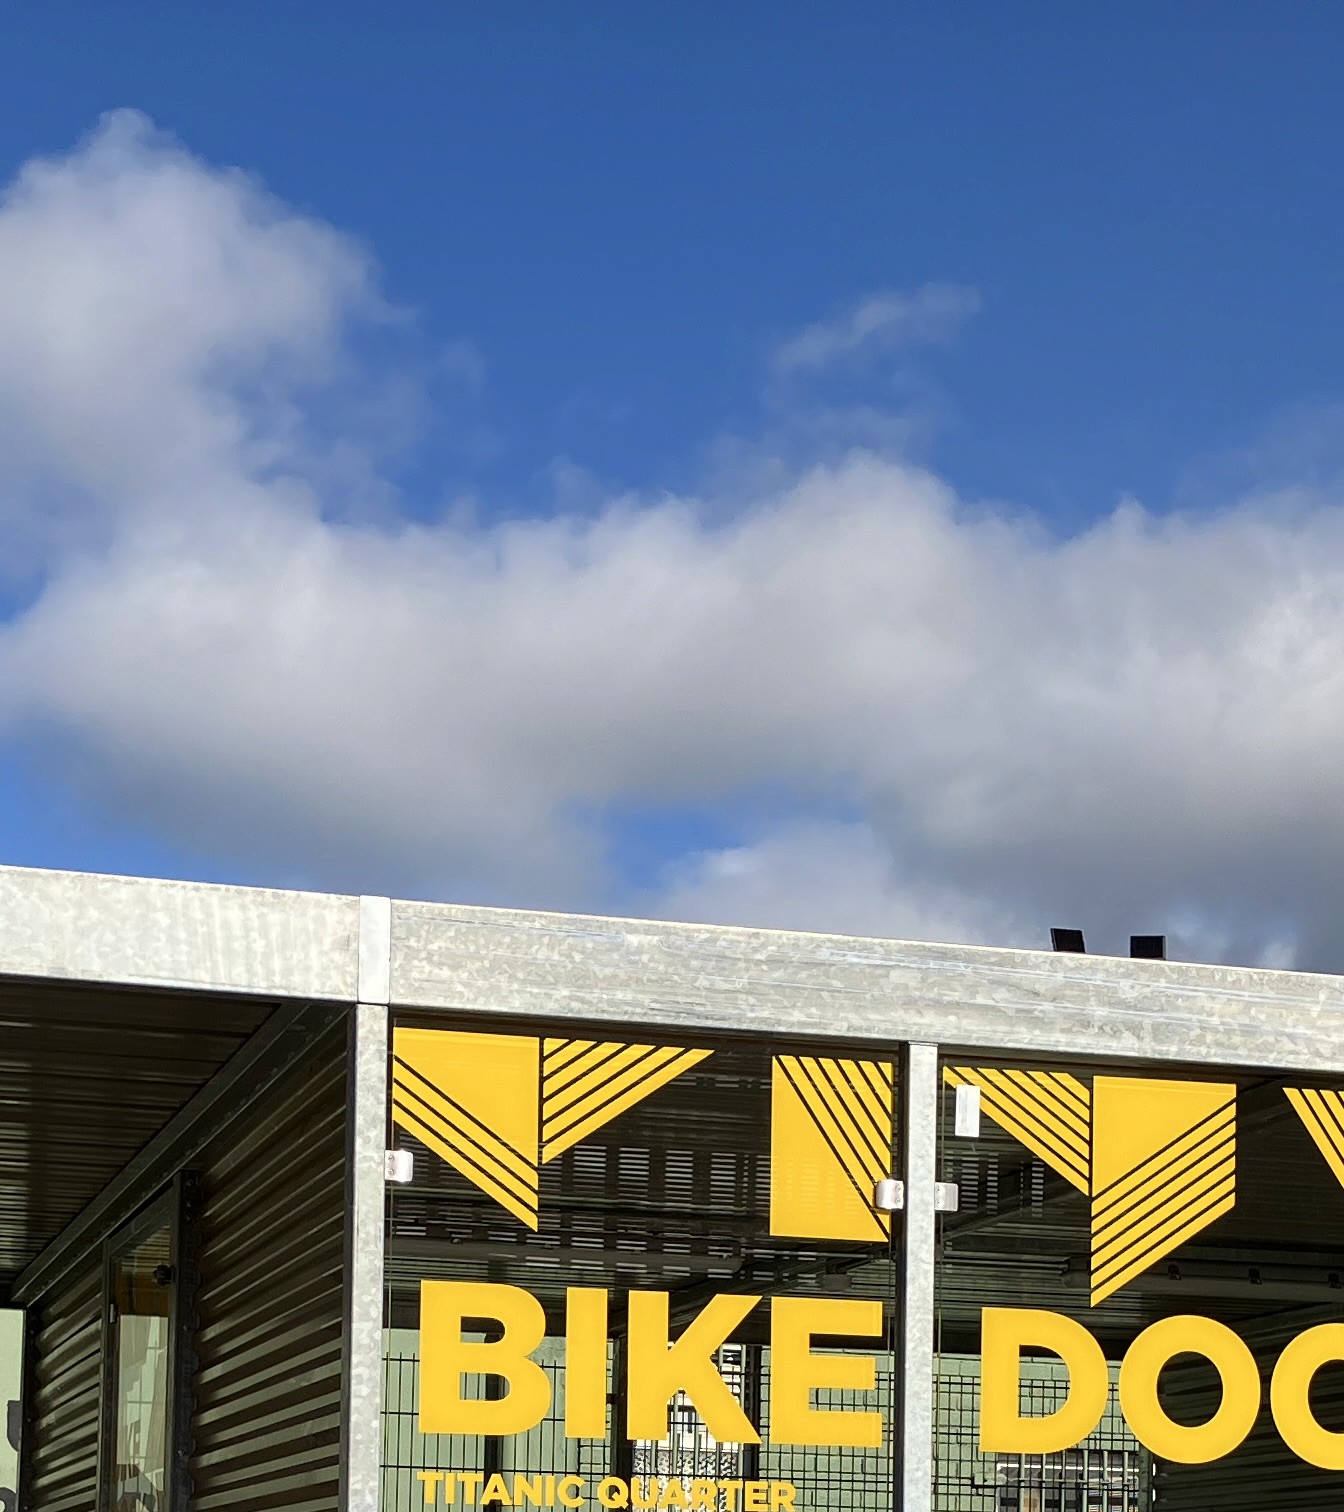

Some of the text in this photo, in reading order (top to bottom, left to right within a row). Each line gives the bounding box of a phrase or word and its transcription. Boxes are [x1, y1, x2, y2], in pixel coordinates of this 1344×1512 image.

[419, 1280, 883, 1448] BIKE
[417, 1471, 796, 1512] TITANIC QUARTER
